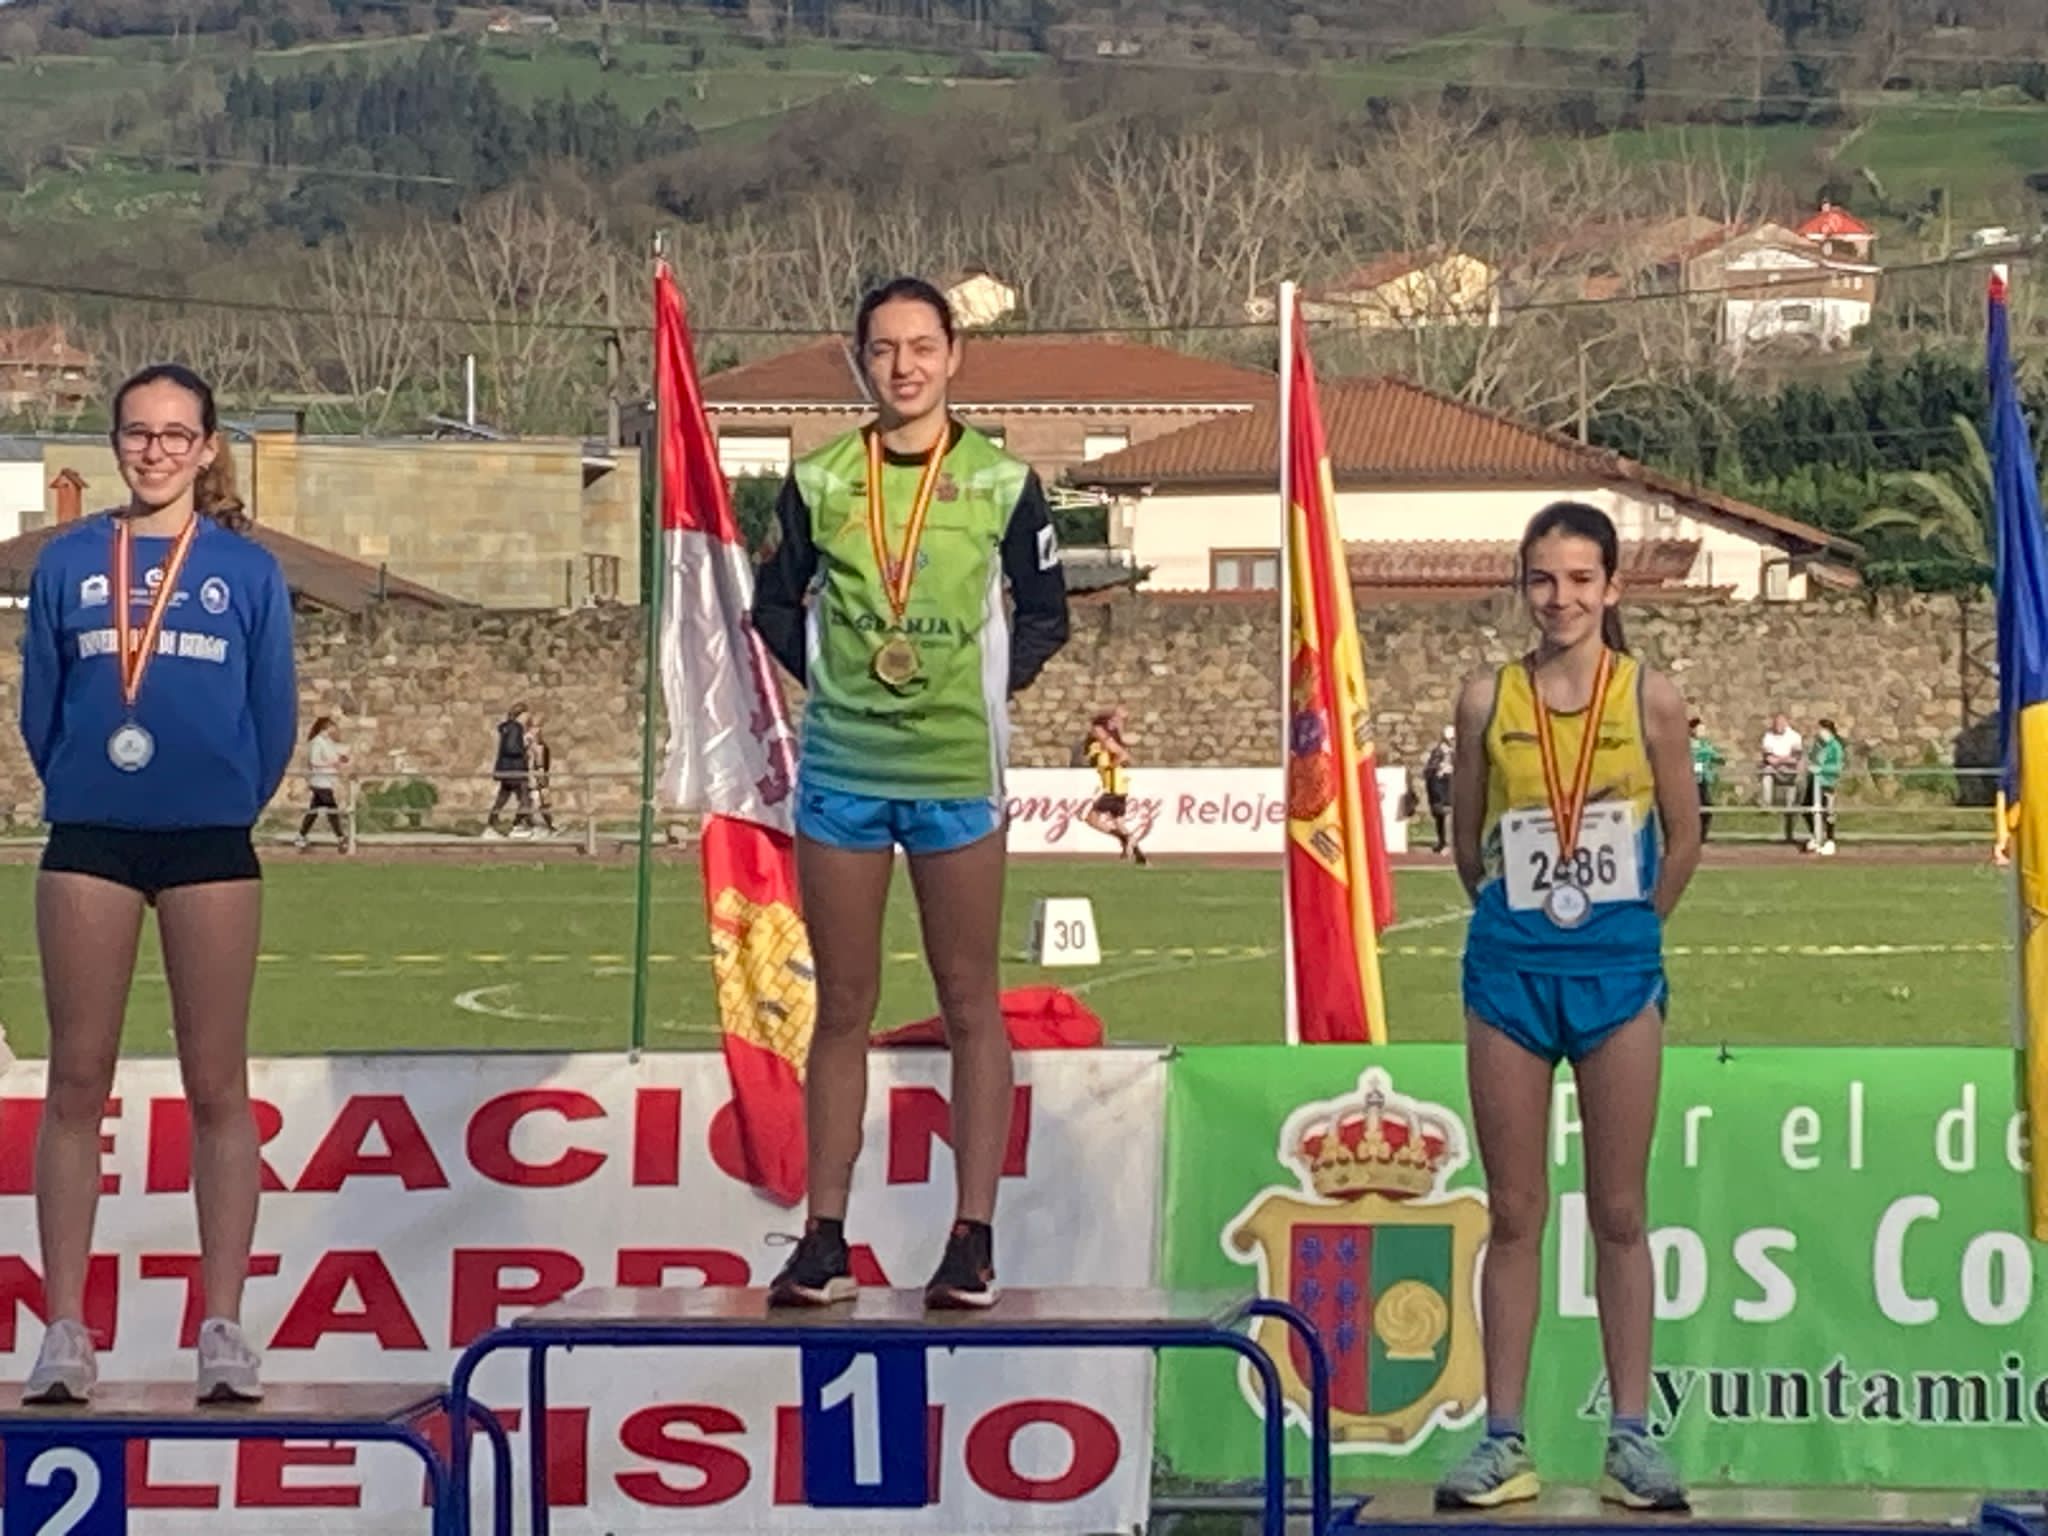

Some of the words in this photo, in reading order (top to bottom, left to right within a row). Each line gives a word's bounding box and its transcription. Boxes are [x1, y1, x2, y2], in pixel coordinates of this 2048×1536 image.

[1528, 844, 1617, 892] 2486
[1053, 919, 1087, 952] 30
[1781, 1079, 1864, 1170] el
[1872, 1194, 2034, 1326] Co
[819, 1351, 884, 1487] 1
[25, 1446, 101, 1536] 2
